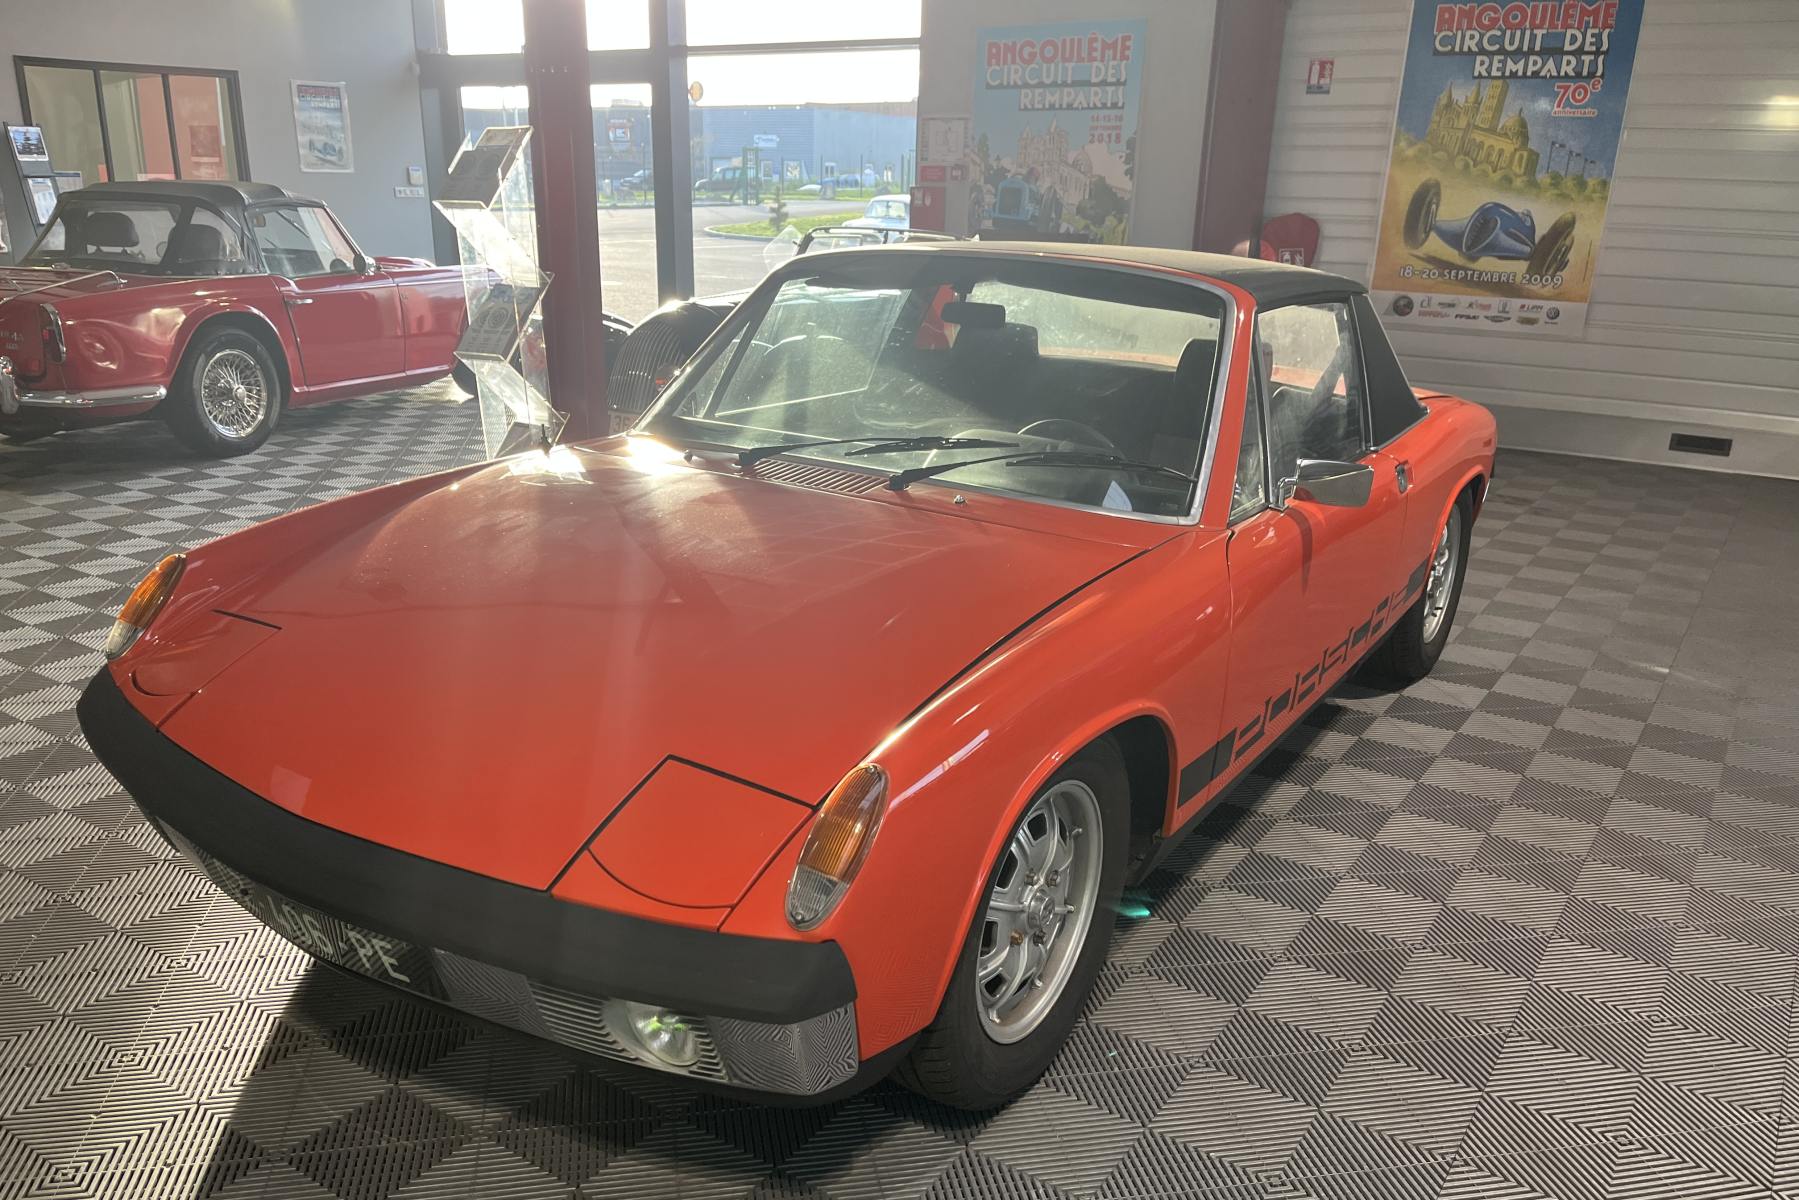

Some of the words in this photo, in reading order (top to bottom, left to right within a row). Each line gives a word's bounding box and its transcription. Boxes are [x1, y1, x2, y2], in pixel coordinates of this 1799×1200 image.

[1434, 0, 1618, 33] ANGOULÊME
[986, 32, 1133, 66] ANGOULÊME
[1434, 28, 1548, 52] CIRCUIT
[1563, 28, 1612, 52] DES
[986, 62, 1074, 86] CIRCUIT
[1091, 61, 1126, 84] DES
[1473, 54, 1604, 78] REMPARTS
[1020, 86, 1125, 110] REMPARTS
[1089, 132, 1122, 145] 2018
[1400, 265, 1439, 280] 18-20
[1443, 269, 1515, 283] SEPTEMBRE
[1520, 273, 1564, 289] 2009
